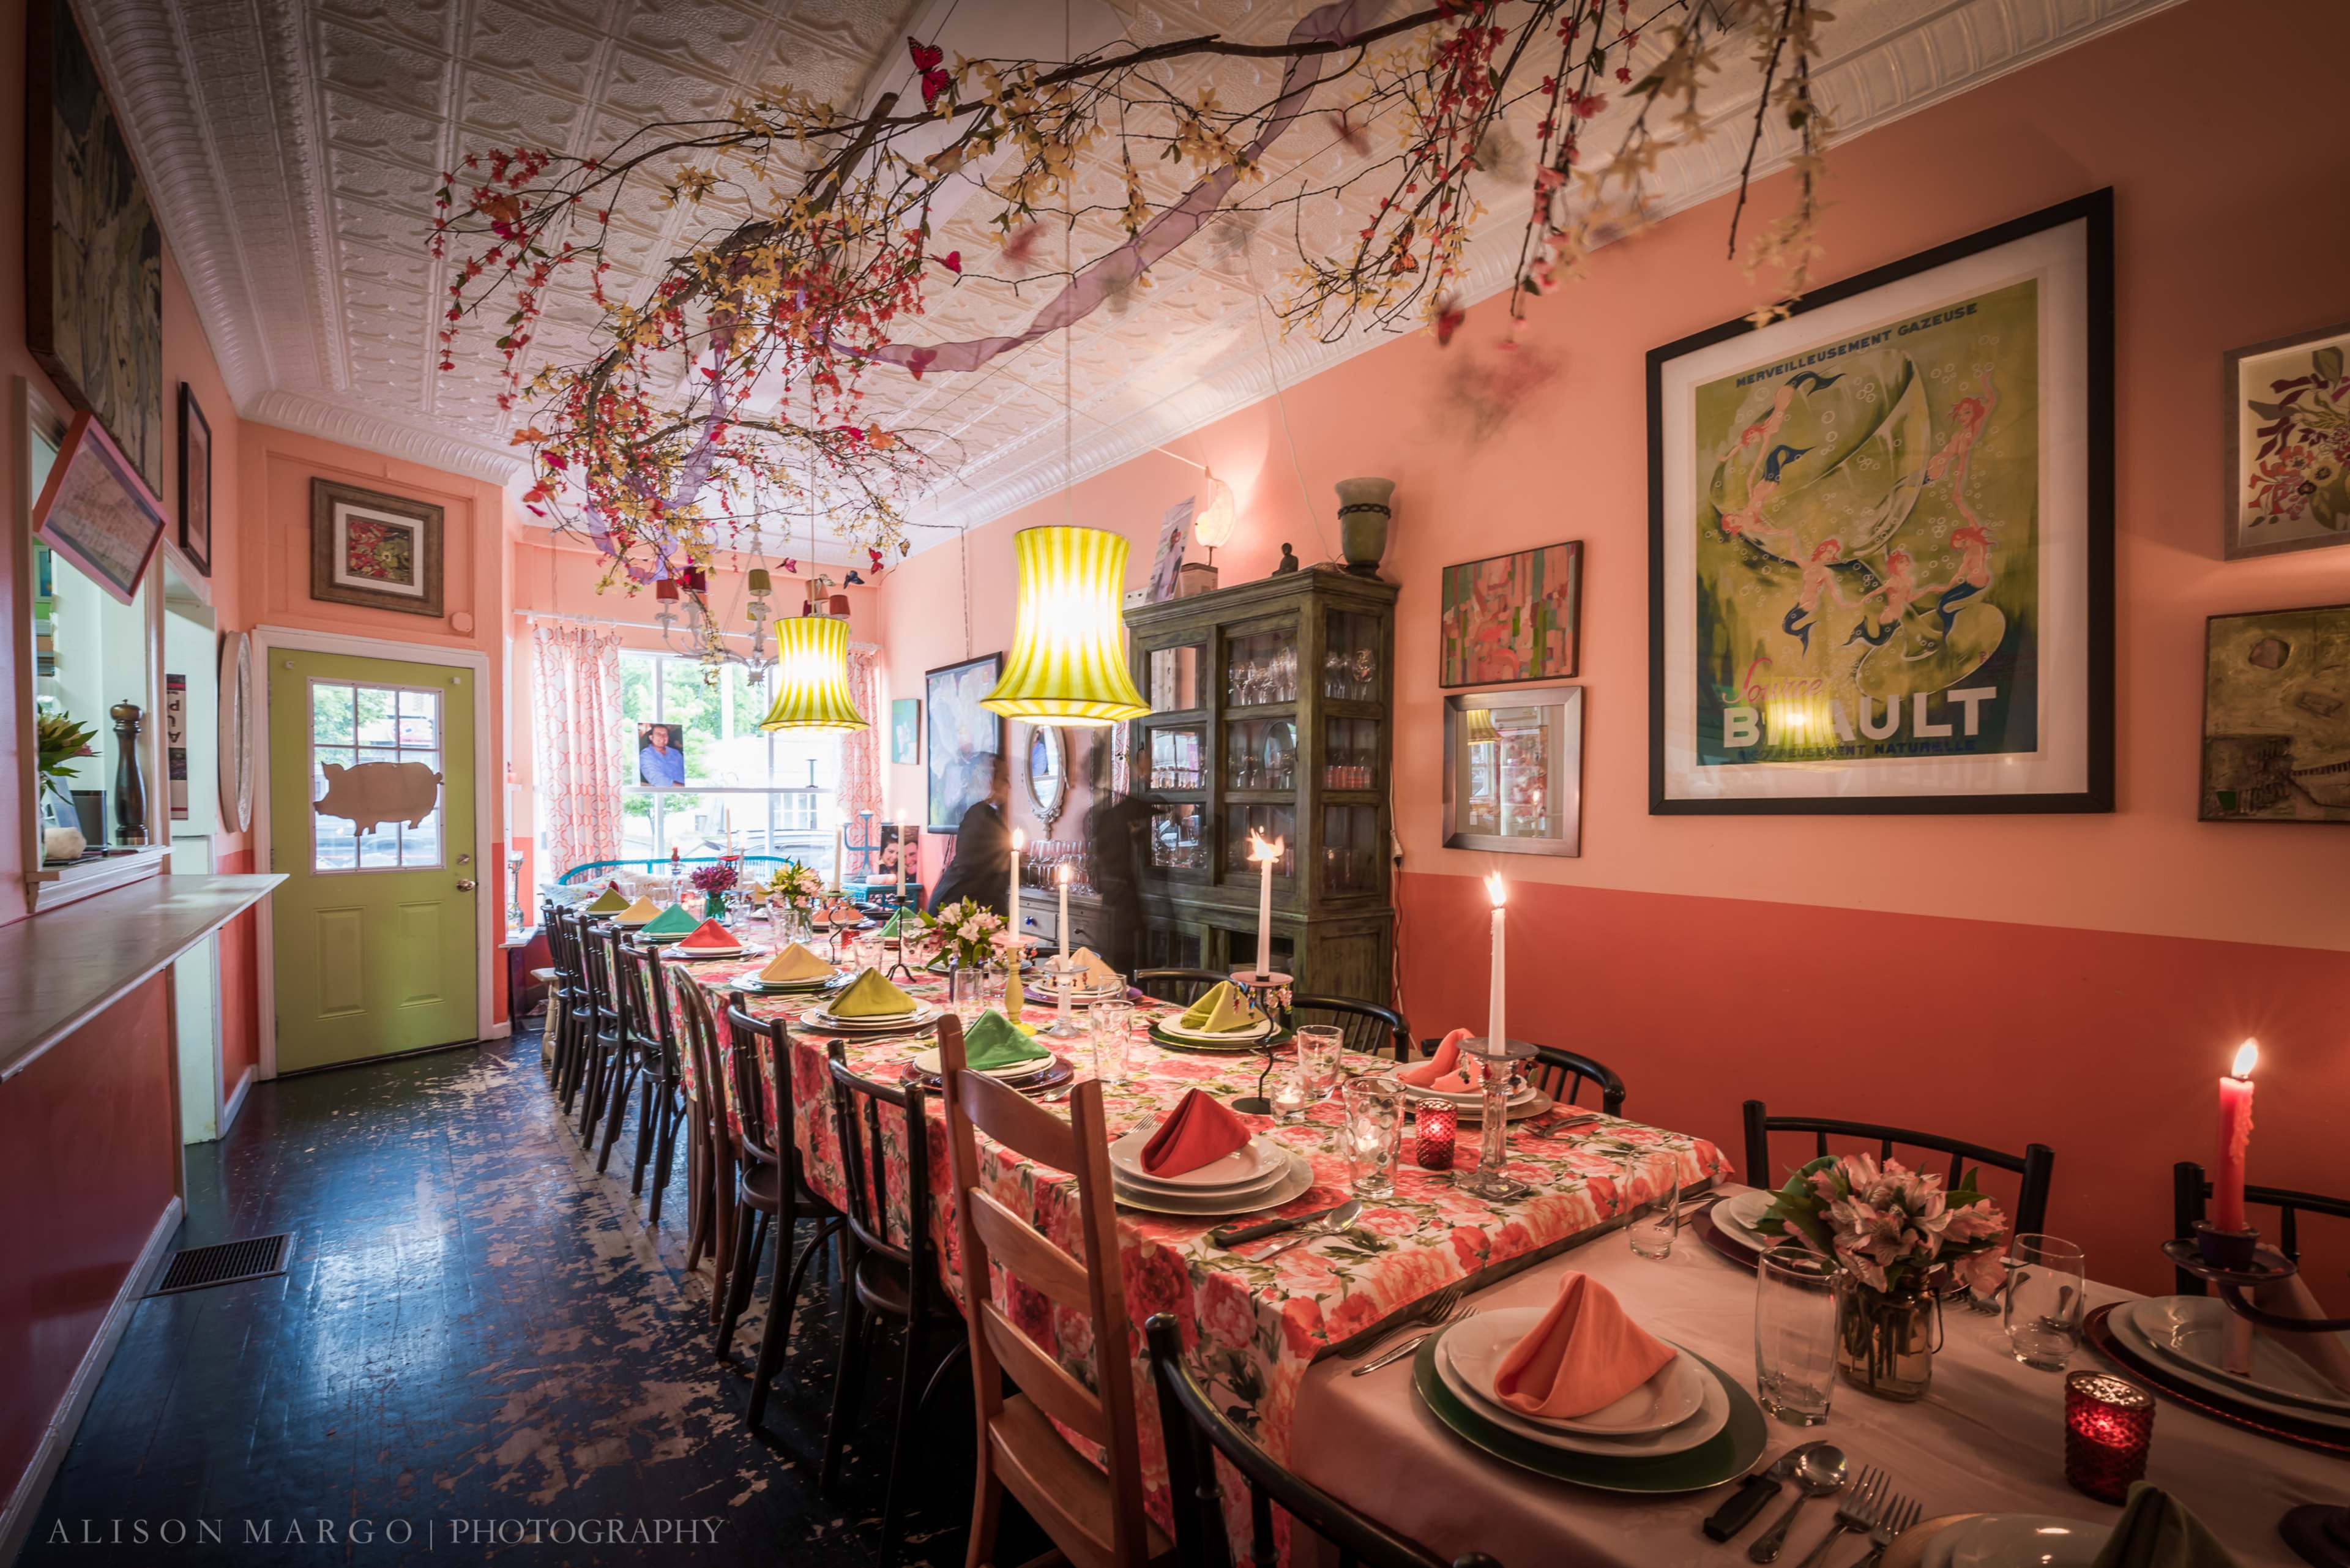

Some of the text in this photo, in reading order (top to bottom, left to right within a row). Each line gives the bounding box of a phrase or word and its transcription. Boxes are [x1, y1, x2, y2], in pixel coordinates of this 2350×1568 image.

[1736, 302, 1978, 388] MERVEILLEUSEMENT GAZEUSE
[1721, 657, 1822, 704] Source
[1874, 739, 1977, 755] NATURELLE
